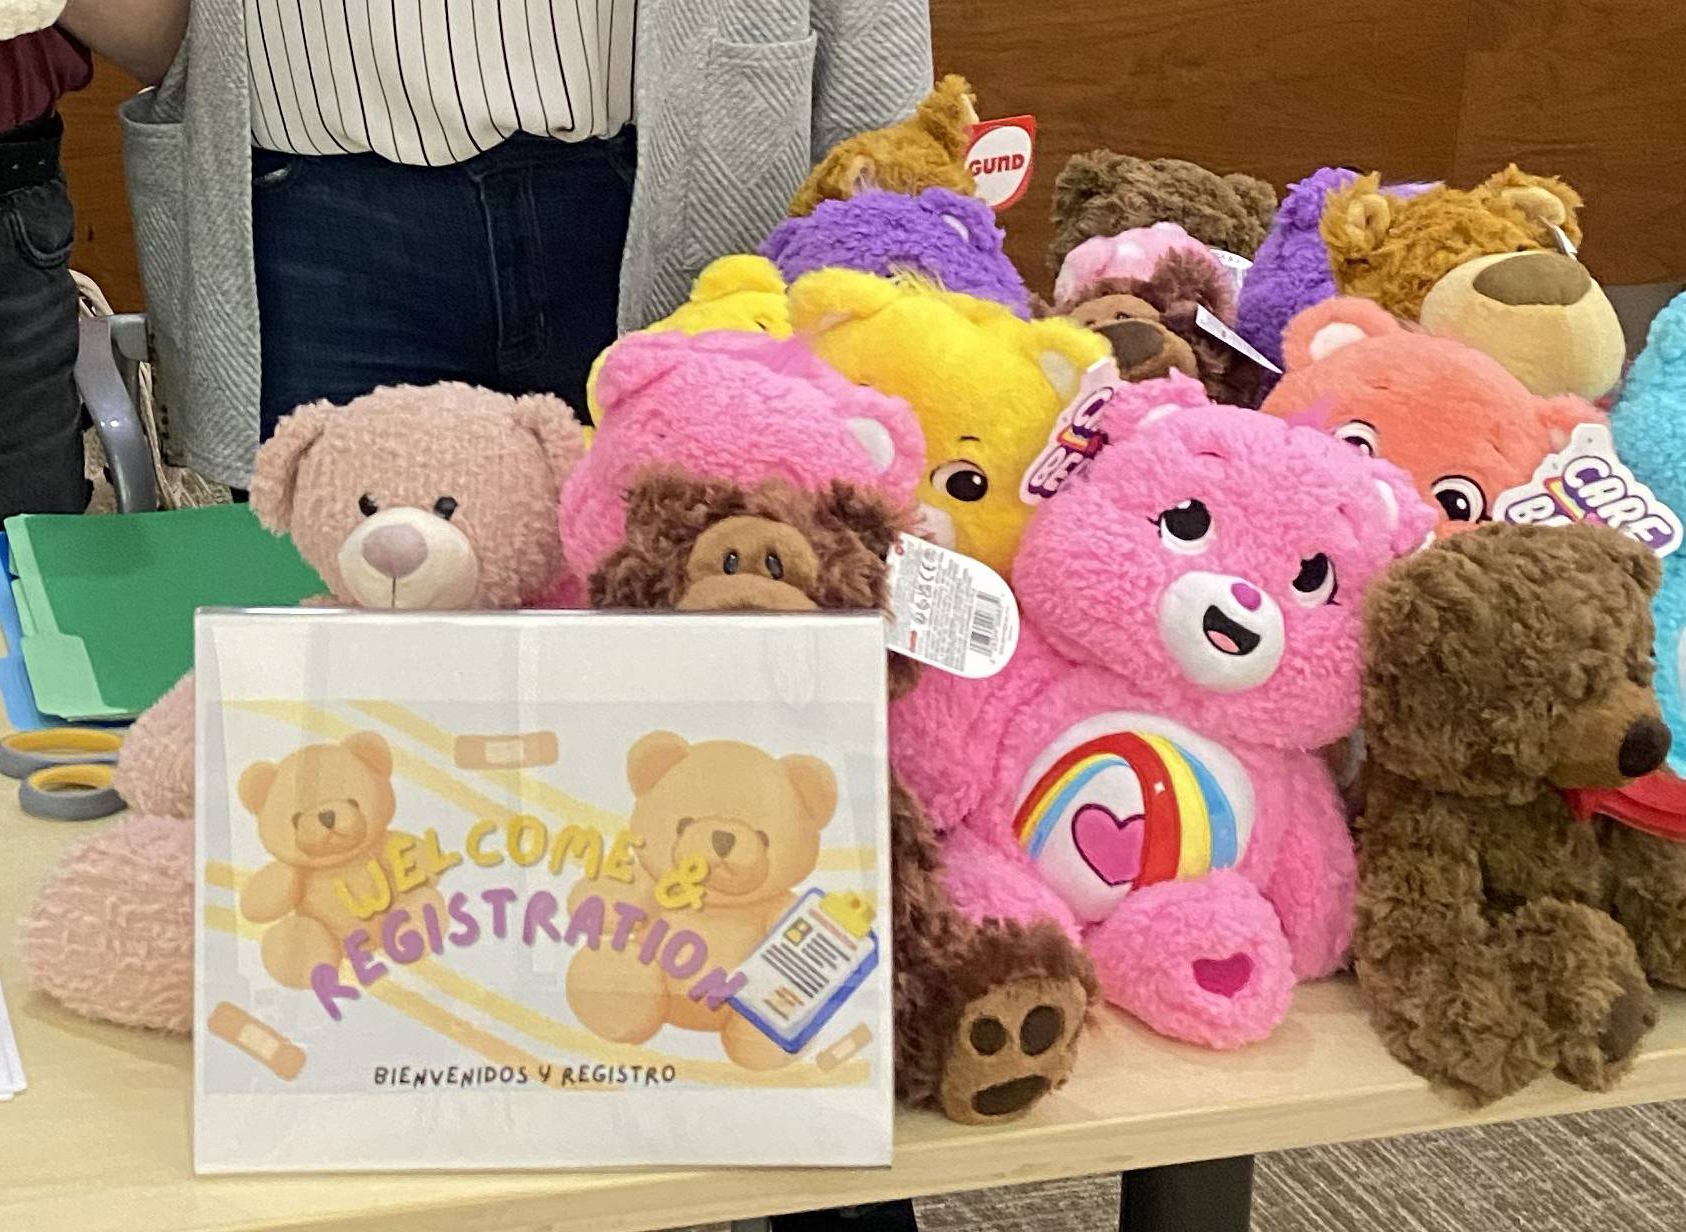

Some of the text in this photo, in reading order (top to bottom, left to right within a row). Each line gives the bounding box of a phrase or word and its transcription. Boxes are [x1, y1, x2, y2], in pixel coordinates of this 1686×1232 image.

[335, 814, 712, 920] WELCOME &
[310, 887, 748, 1022] REGISTRATION
[374, 1063, 676, 1089] BIENVENIDOS Y REGISTRO
